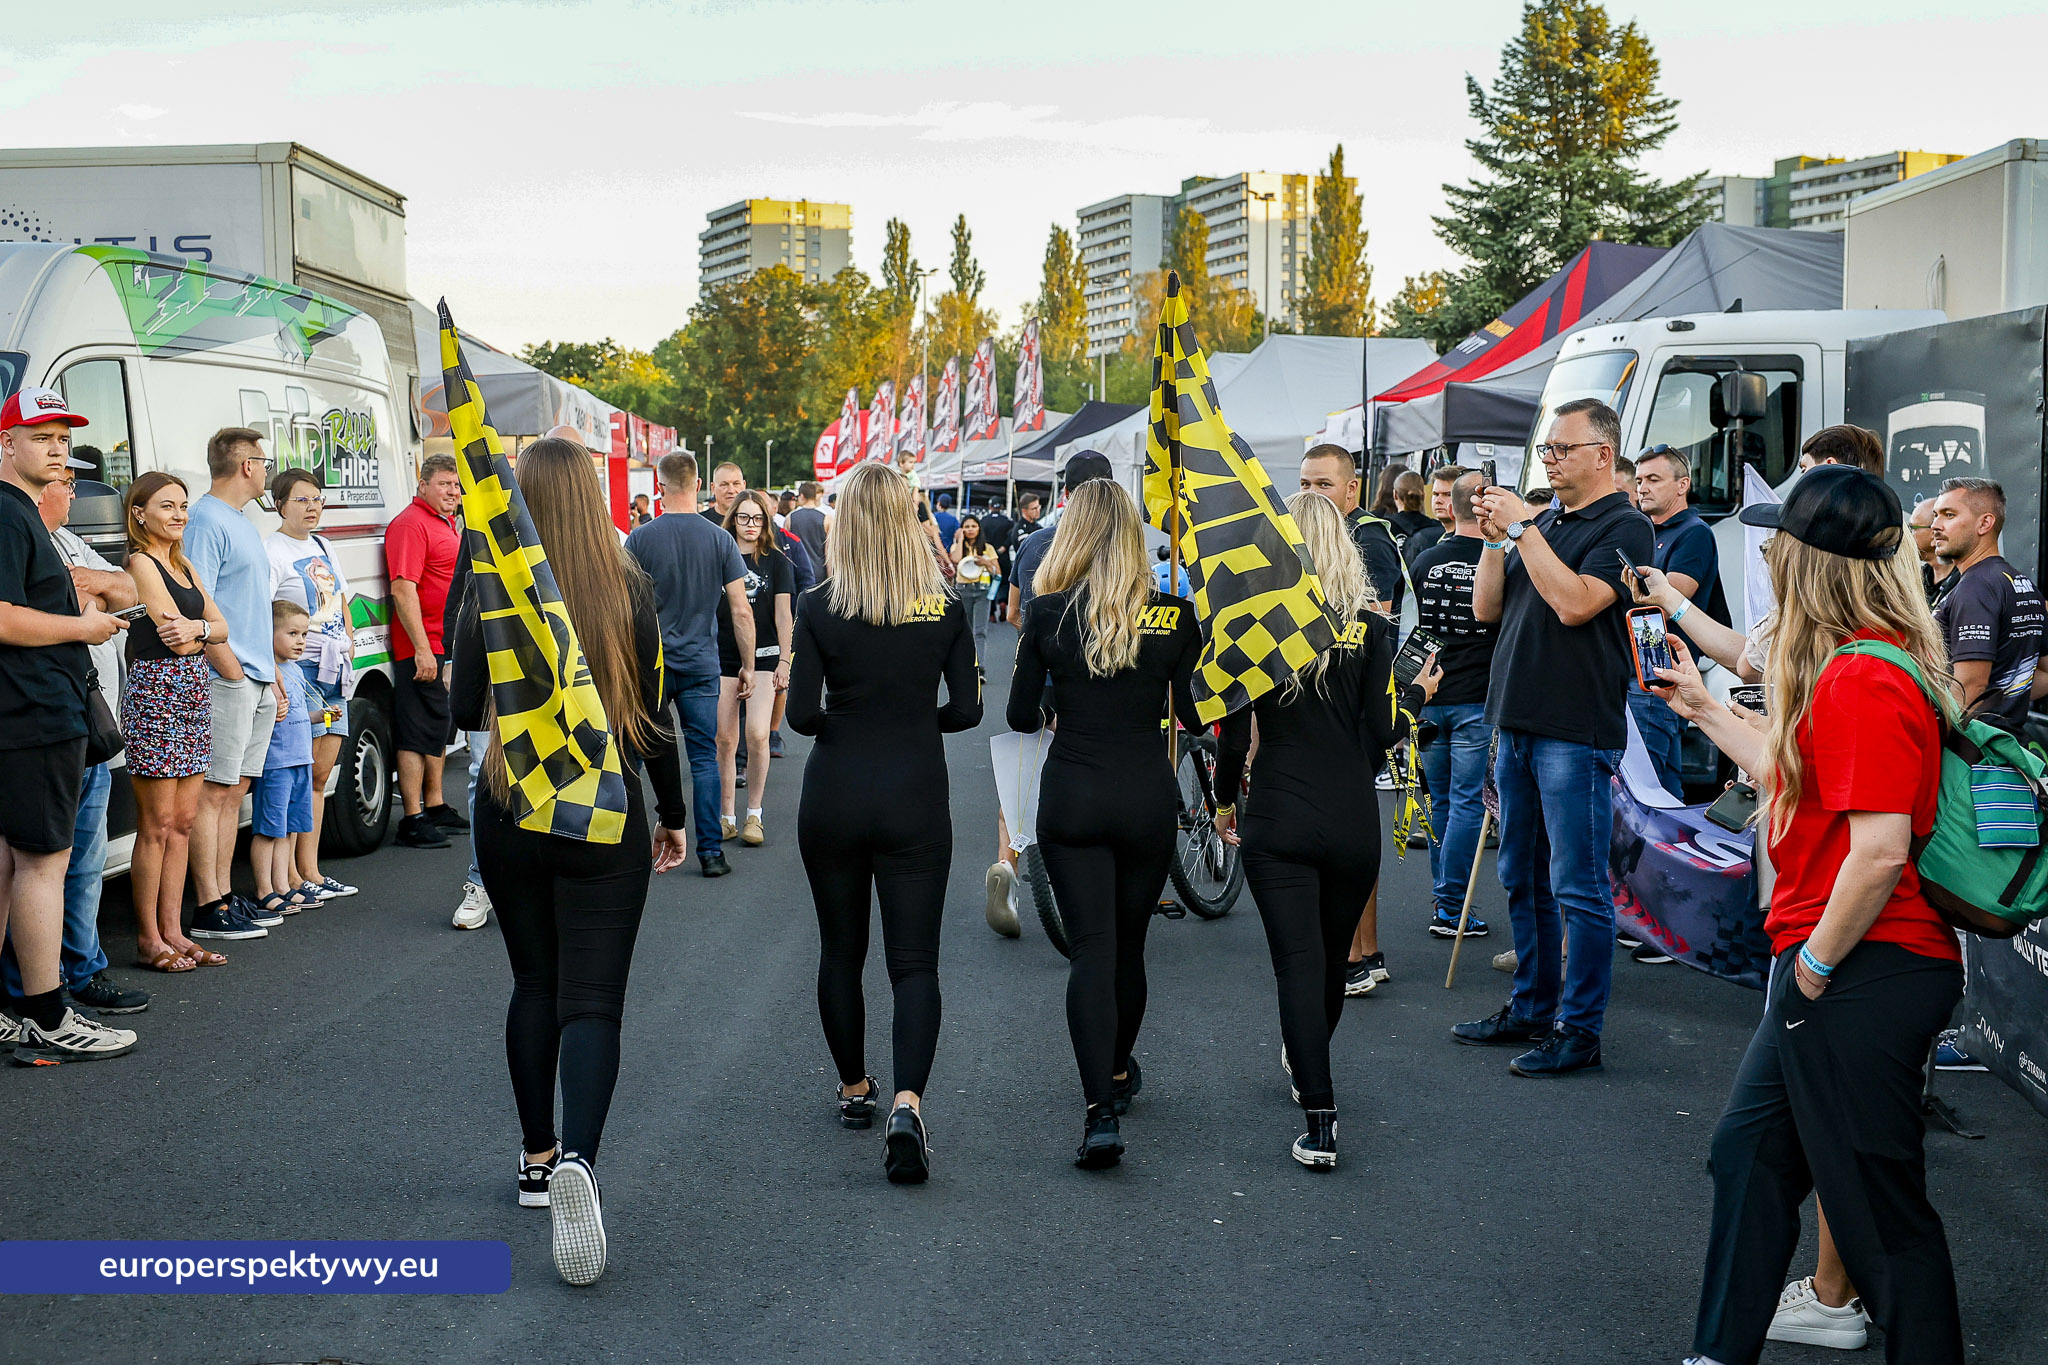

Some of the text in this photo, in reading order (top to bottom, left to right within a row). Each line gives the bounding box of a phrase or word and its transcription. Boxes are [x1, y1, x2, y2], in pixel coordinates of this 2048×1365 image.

[322, 408, 377, 457] RALLY
[341, 457, 379, 488] HIRE
[340, 490, 379, 503] & Preperation
[2012, 933, 2035, 966] RALLY
